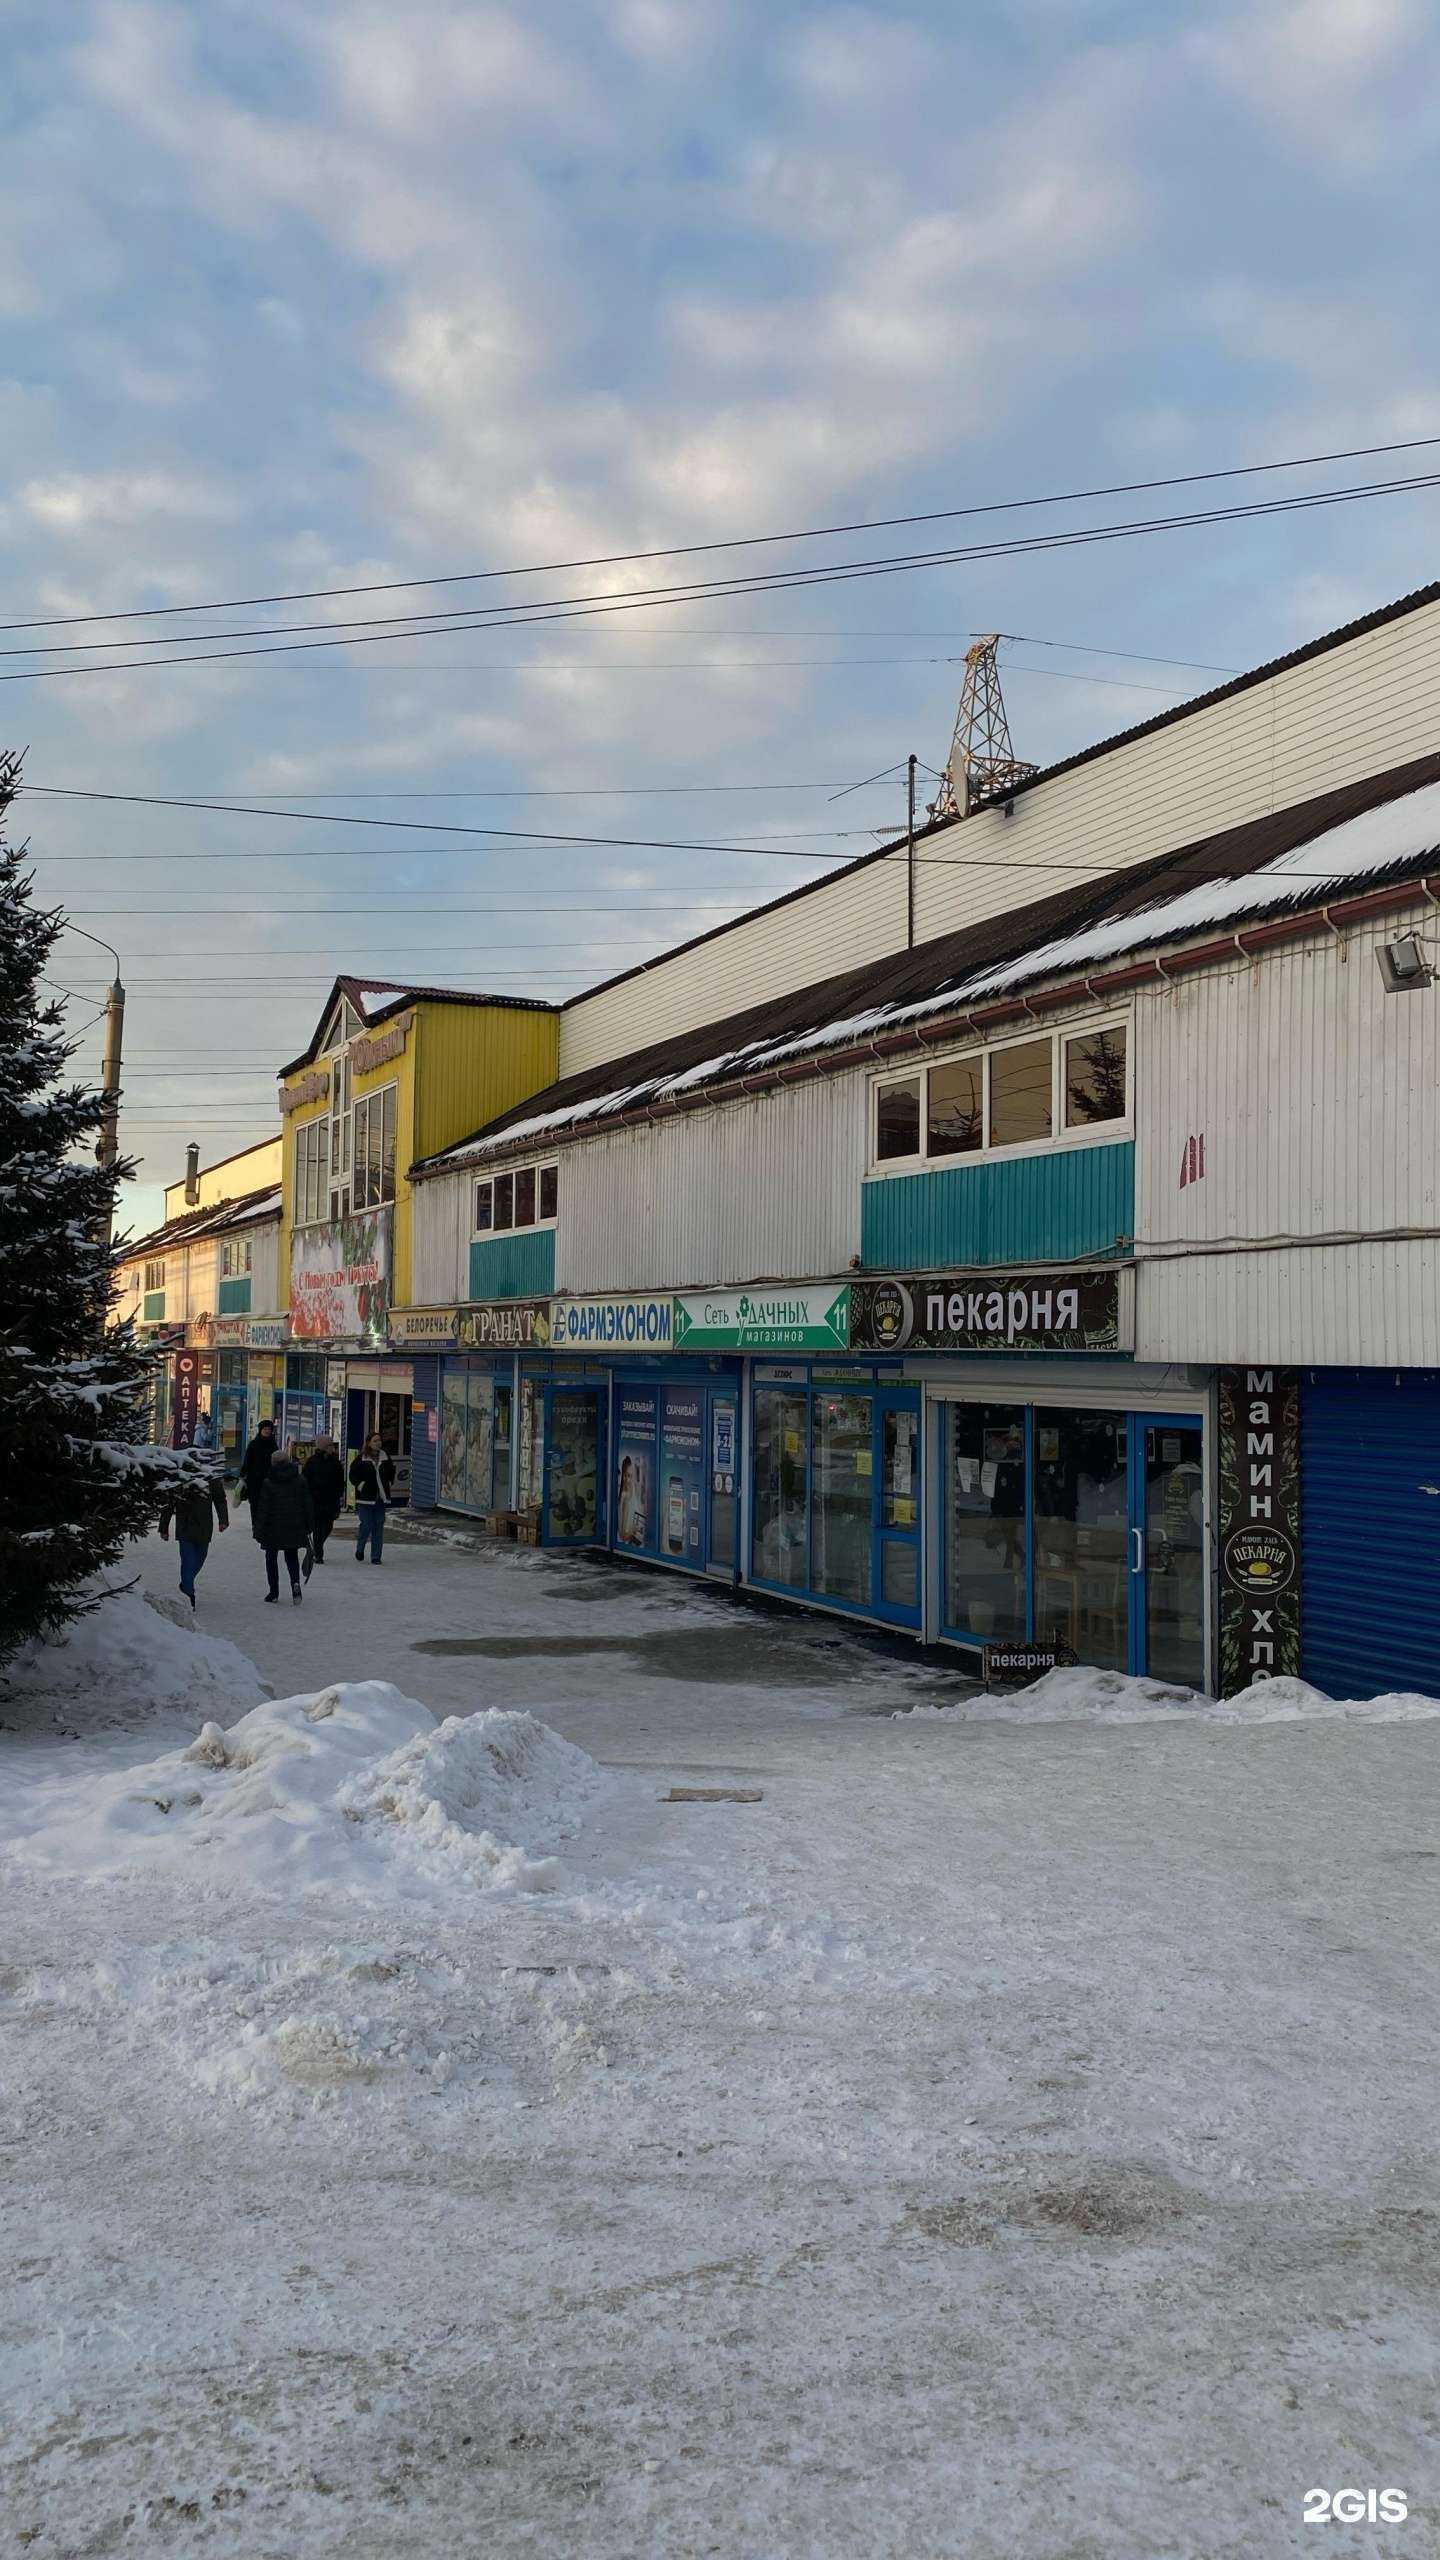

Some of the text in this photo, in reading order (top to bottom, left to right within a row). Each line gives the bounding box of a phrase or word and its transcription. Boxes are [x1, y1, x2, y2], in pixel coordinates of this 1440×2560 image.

[406, 1315, 448, 1333] БЕЛОРЕЧЬЕ
[471, 1307, 535, 1342] ГРАНАТ
[567, 1303, 671, 1341] ФАРМЭКОНОМ
[675, 1310, 685, 1333] 11
[704, 1304, 729, 1325] Сеть
[833, 1303, 847, 1330] 11
[927, 1289, 1079, 1344] пекарня
[746, 1330, 805, 1343] магазинов
[180, 1376, 190, 1444] АПТЕКА
[1233, 1545, 1288, 1563] ПЕКАРНЯ
[991, 1654, 1056, 1670] пекарня
